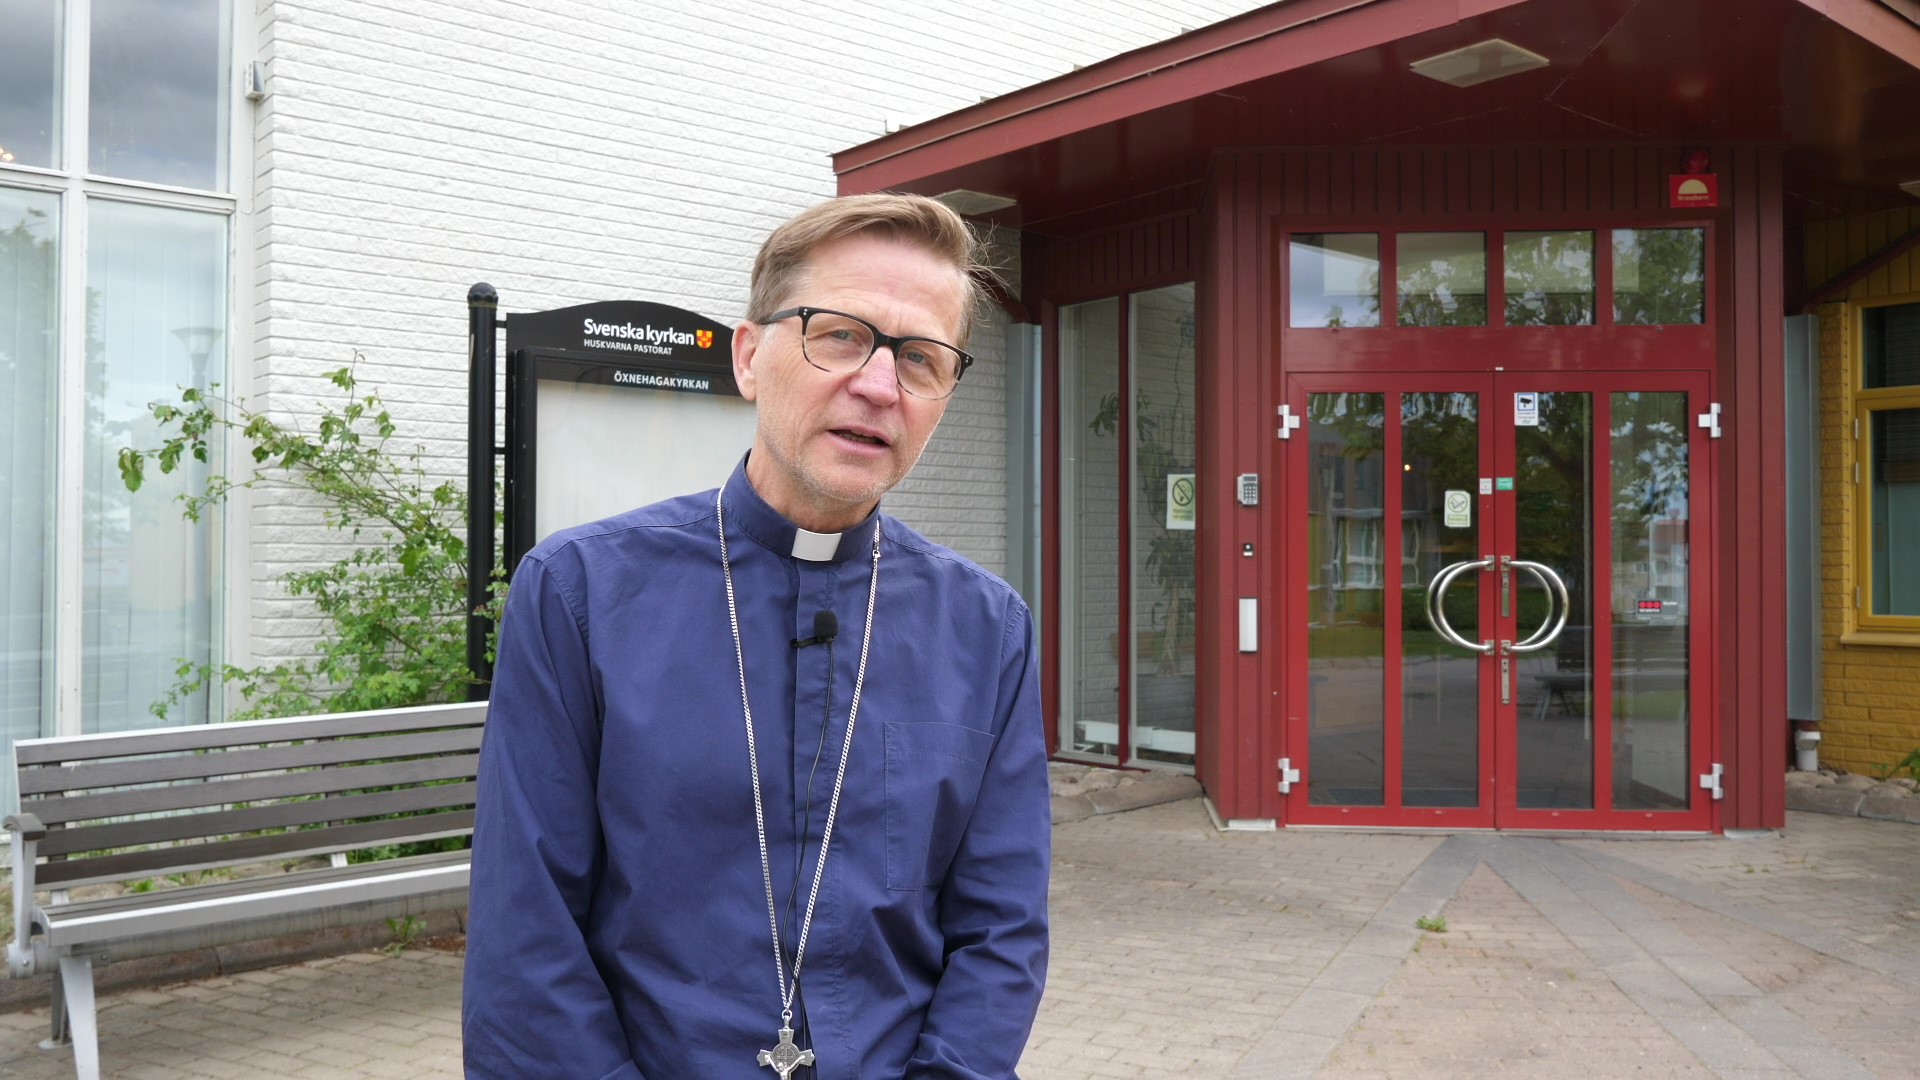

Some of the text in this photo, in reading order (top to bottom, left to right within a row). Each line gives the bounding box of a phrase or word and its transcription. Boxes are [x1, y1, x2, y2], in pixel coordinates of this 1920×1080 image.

[584, 318, 694, 345] Svenska kyrkan
[584, 339, 673, 355] HUSKVARNA PASTORAT
[613, 370, 709, 390] ÖXNEHAGAKYRKAN
